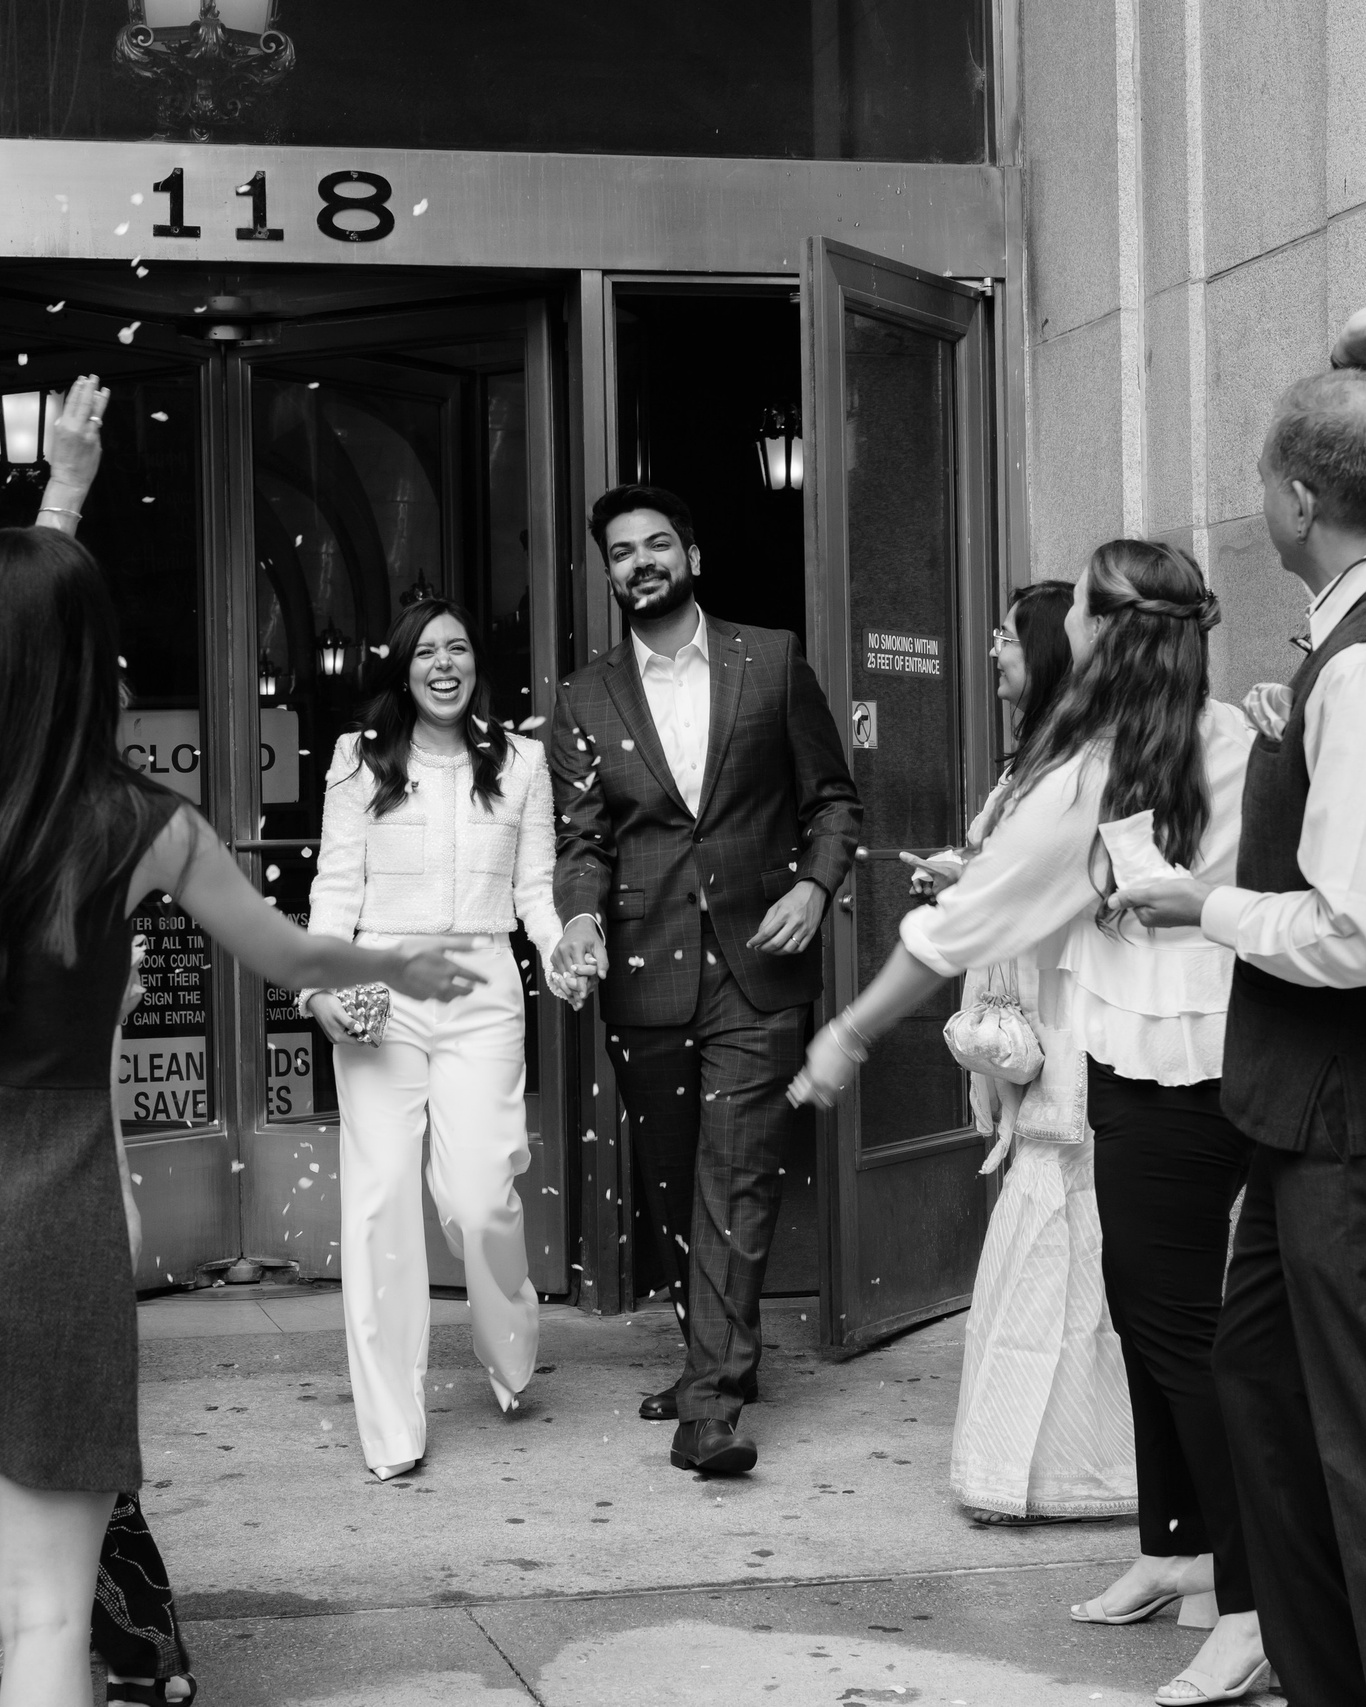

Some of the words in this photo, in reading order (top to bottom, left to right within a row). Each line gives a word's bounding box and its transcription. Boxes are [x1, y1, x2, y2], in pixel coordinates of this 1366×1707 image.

[153, 167, 395, 242] 118
[868, 632, 880, 649] NO
[881, 634, 913, 652] SMOKING
[914, 637, 938, 655] WITHIN
[867, 652, 876, 668] 25
[877, 653, 894, 670] FEET
[894, 655, 904, 671] OF
[905, 657, 940, 674] ENTRANCE
[121, 743, 276, 774] CLOD
[158, 916, 186, 930] 6:00
[162, 936, 182, 949] ALL
[170, 953, 205, 968] COUNT
[167, 972, 200, 987] THEIR
[143, 991, 173, 1006] SIGN
[177, 991, 202, 1005] THE
[133, 1011, 160, 1026] GAIN
[118, 1051, 205, 1084] CLEAN
[133, 1089, 207, 1120] SAVE
